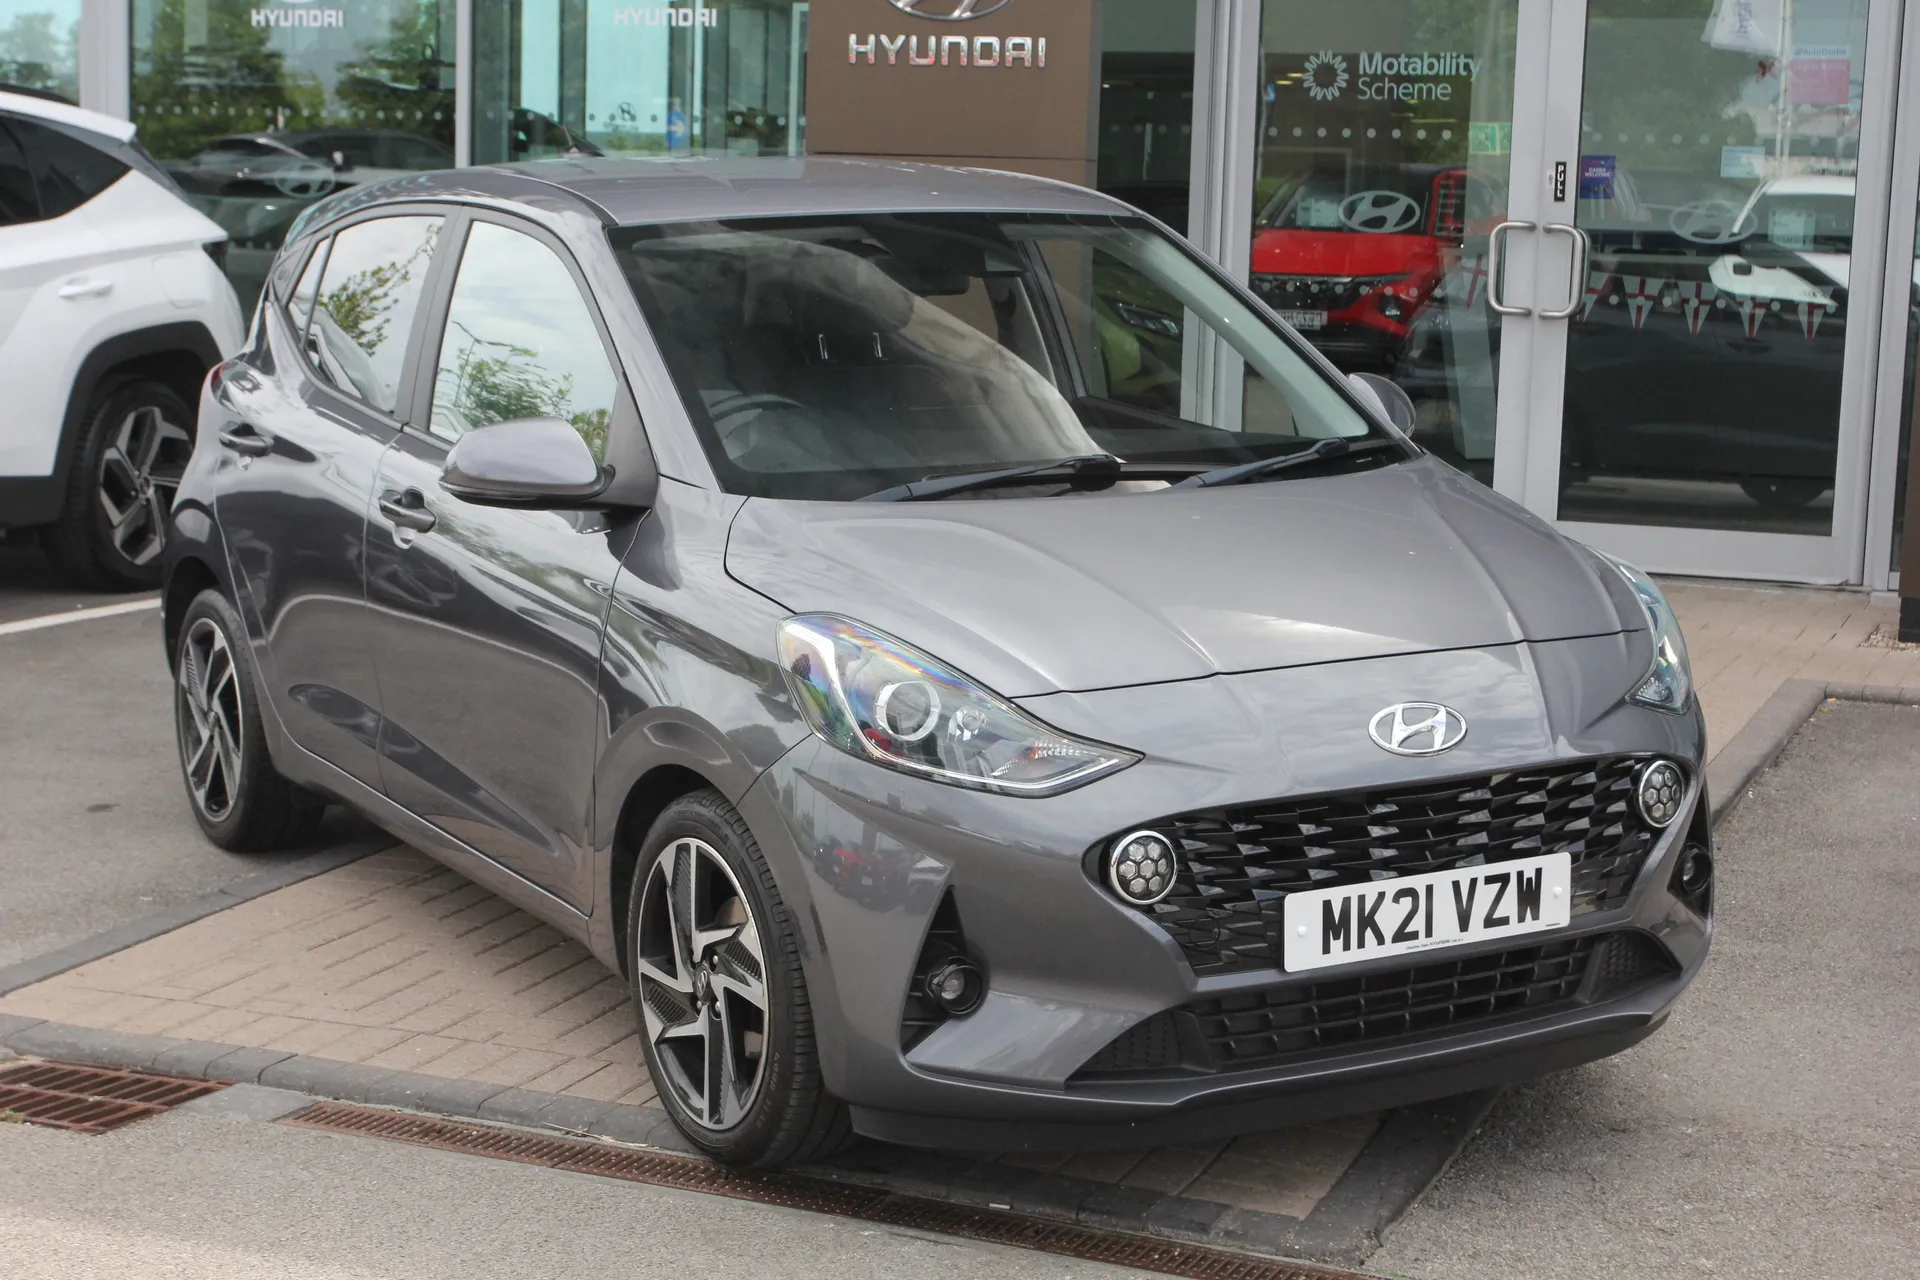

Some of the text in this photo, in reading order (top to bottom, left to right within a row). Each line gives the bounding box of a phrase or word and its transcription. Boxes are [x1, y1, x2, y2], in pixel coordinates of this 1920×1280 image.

[250, 8, 344, 28] HYUNDAI
[613, 8, 717, 27] HYUNDAI
[848, 33, 1046, 68] HYUNDAI
[1358, 51, 1483, 82] Motability
[1357, 77, 1452, 101] Scheme
[1556, 164, 1565, 198] PULL
[1322, 867, 1543, 955] MK21 VZW
